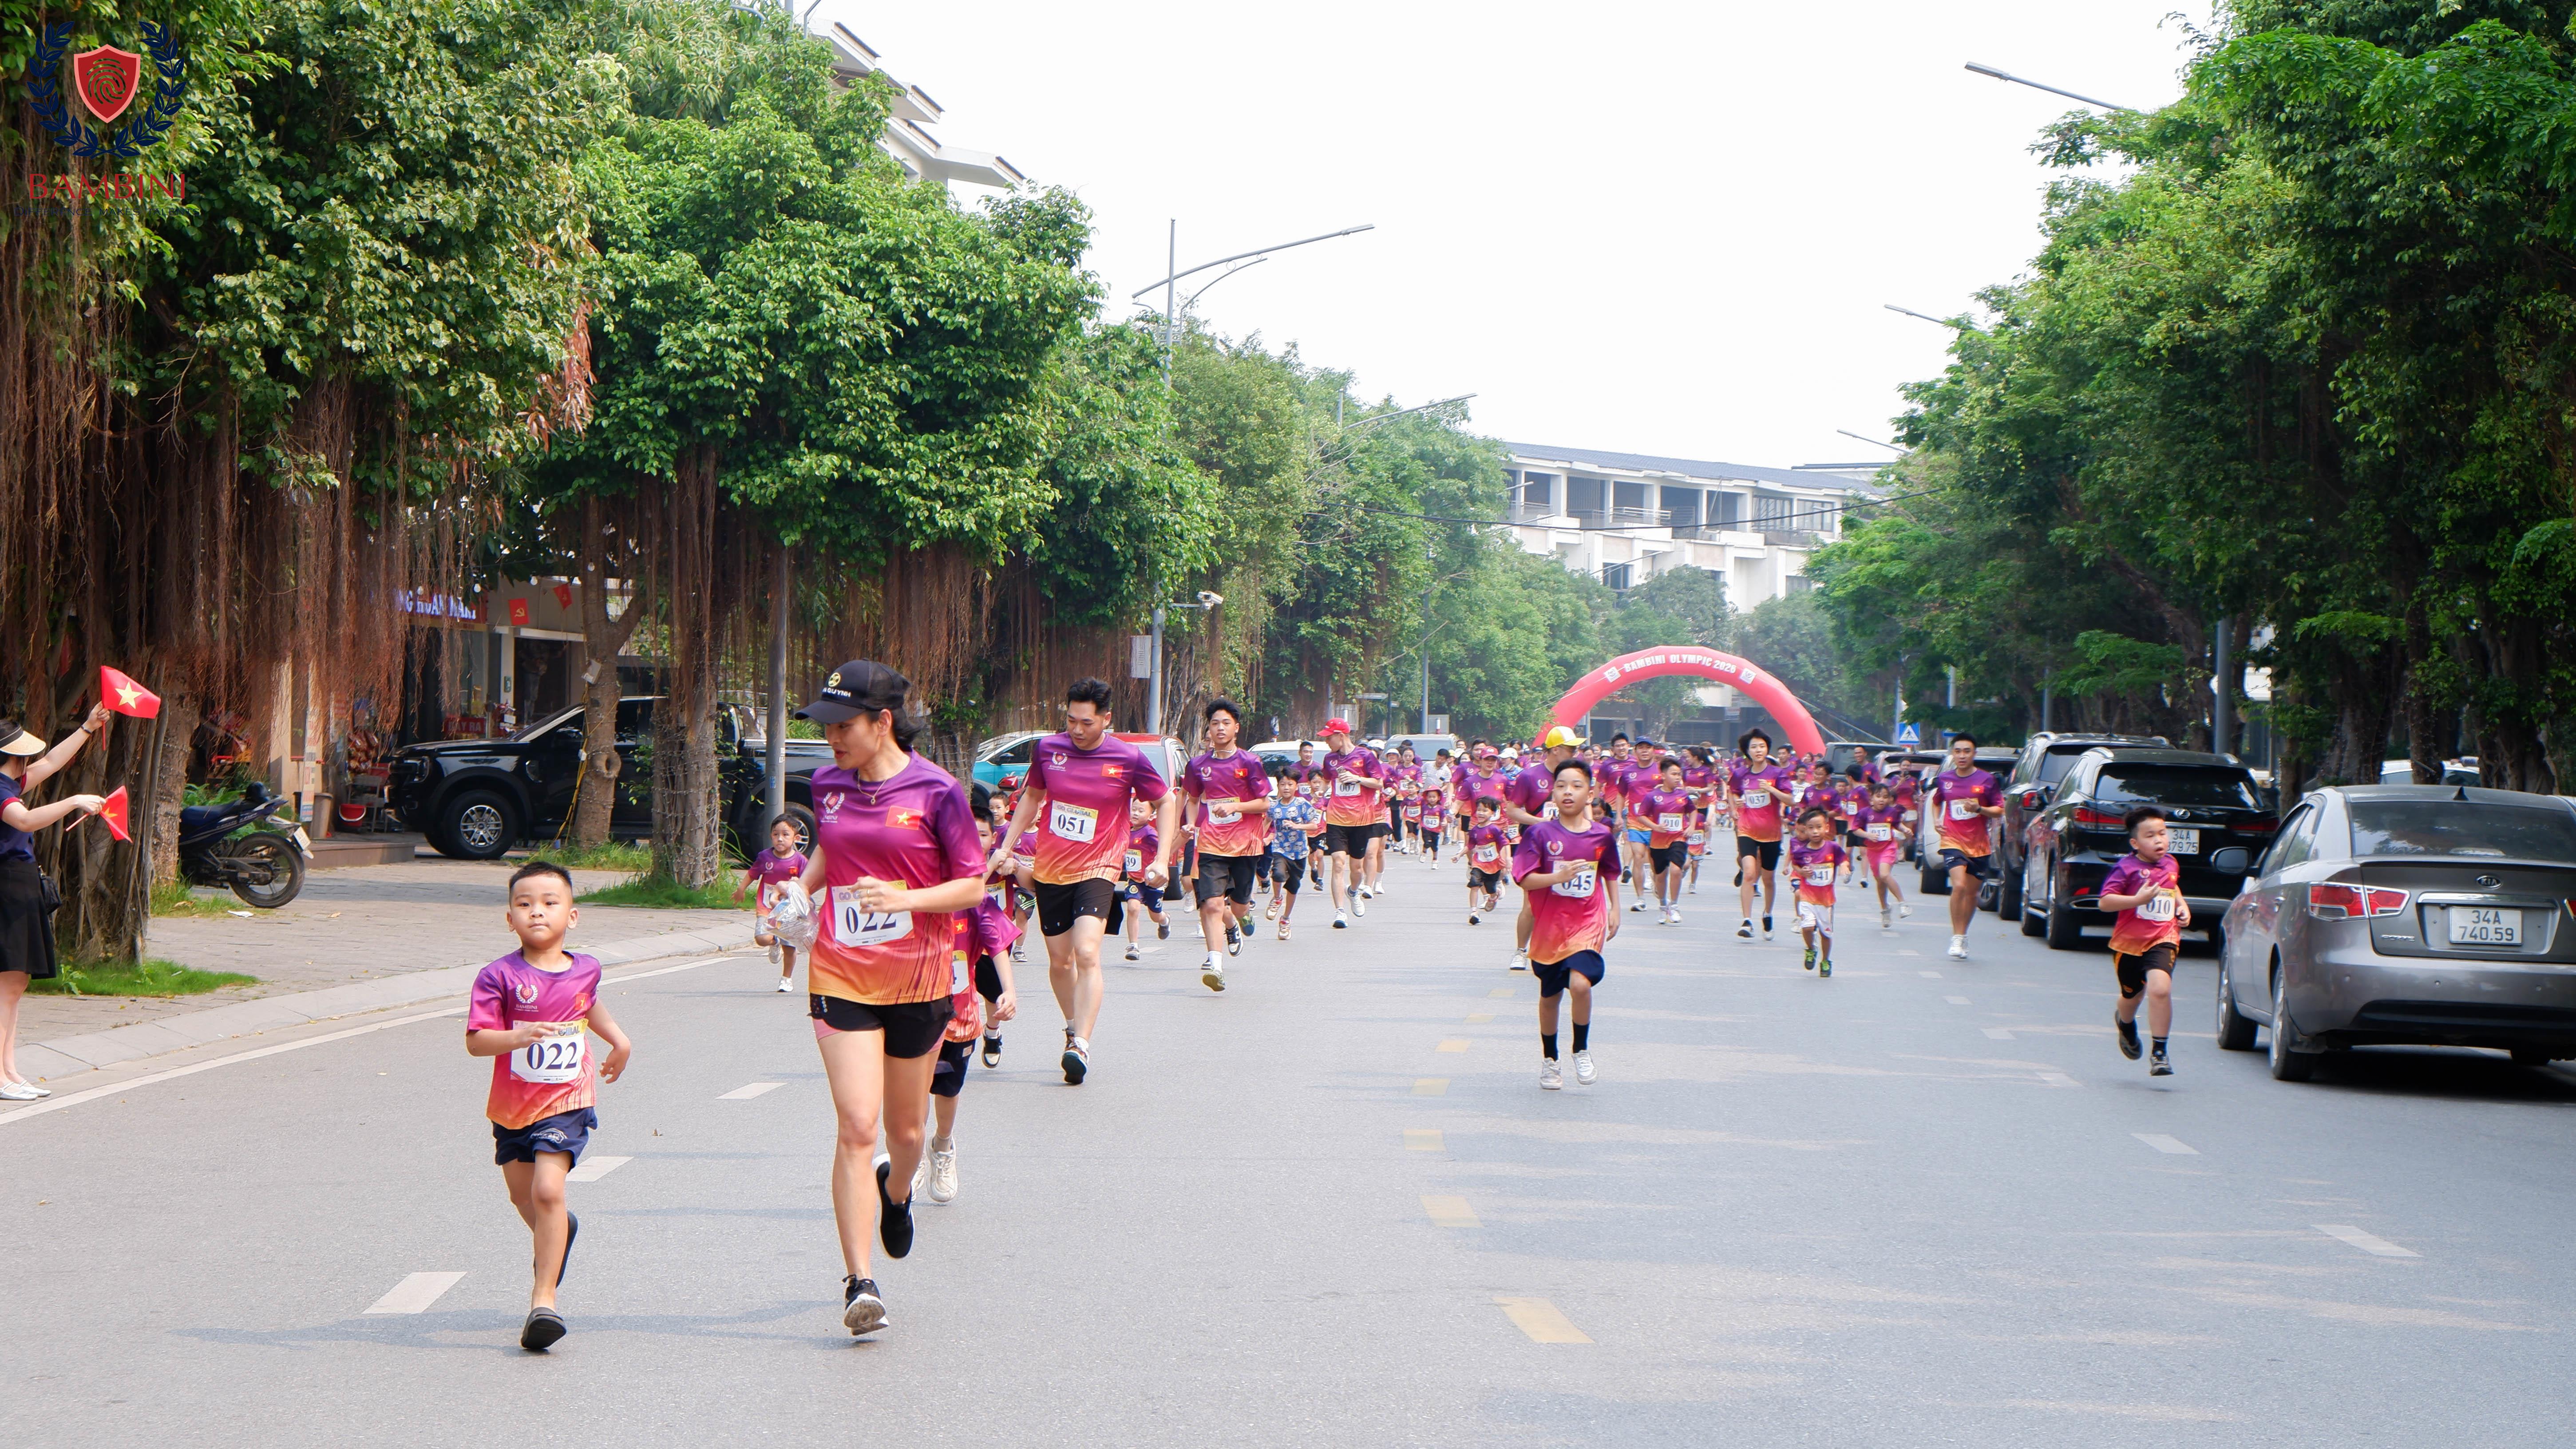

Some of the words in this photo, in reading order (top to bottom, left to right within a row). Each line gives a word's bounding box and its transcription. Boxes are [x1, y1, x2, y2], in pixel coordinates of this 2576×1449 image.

[1624, 655, 1666, 672] BAMBINI
[1669, 654, 1713, 667] OLYMPIC
[1750, 795, 1765, 804] 037
[1058, 814, 1085, 835] 051
[2173, 829, 2191, 841] 34A
[1125, 857, 1136, 867] 39
[1562, 875, 1592, 891] 045
[839, 892, 851, 901] GO
[2146, 898, 2171, 915] 010
[846, 906, 897, 934] 022
[2472, 910, 2501, 924] 34A
[2459, 926, 2514, 942] 740.59
[550, 1026, 580, 1037] LOBAL
[527, 1042, 577, 1070] 022
